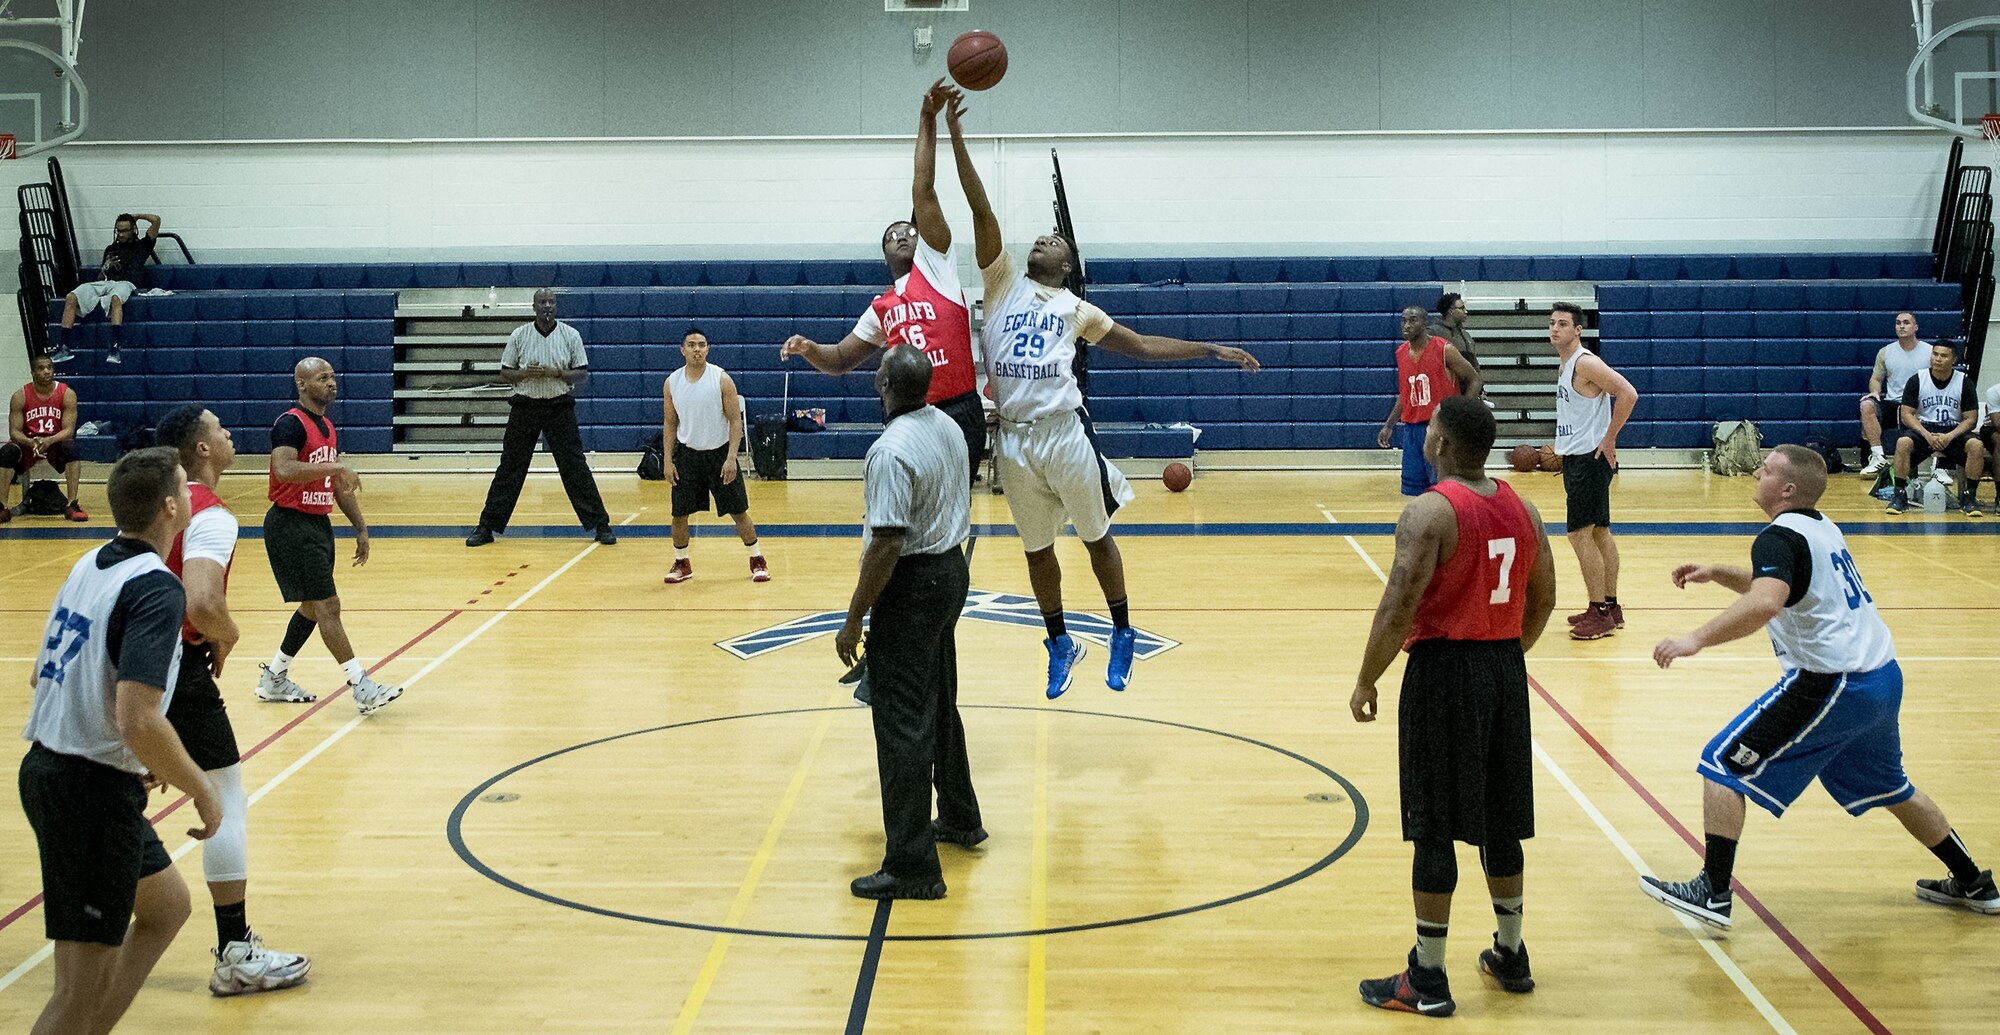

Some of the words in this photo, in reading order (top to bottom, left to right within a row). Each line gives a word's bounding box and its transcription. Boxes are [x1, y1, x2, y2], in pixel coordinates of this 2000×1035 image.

[882, 304, 906, 337] EGLIN
[908, 302, 937, 320] AFB
[1040, 313, 1064, 337] AFB
[900, 324, 927, 350] 16
[1013, 332, 1045, 358] 29
[995, 361, 1060, 380] BASKETBALL
[26, 406, 48, 422] EGLIN
[48, 406, 62, 420] AFB
[1922, 396, 1943, 409] EGLIN
[1943, 396, 1960, 410] AFB
[1936, 408, 1950, 422] 10
[38, 419, 55, 433] 14
[1487, 537, 1517, 605] 7
[1829, 548, 1873, 611] 30
